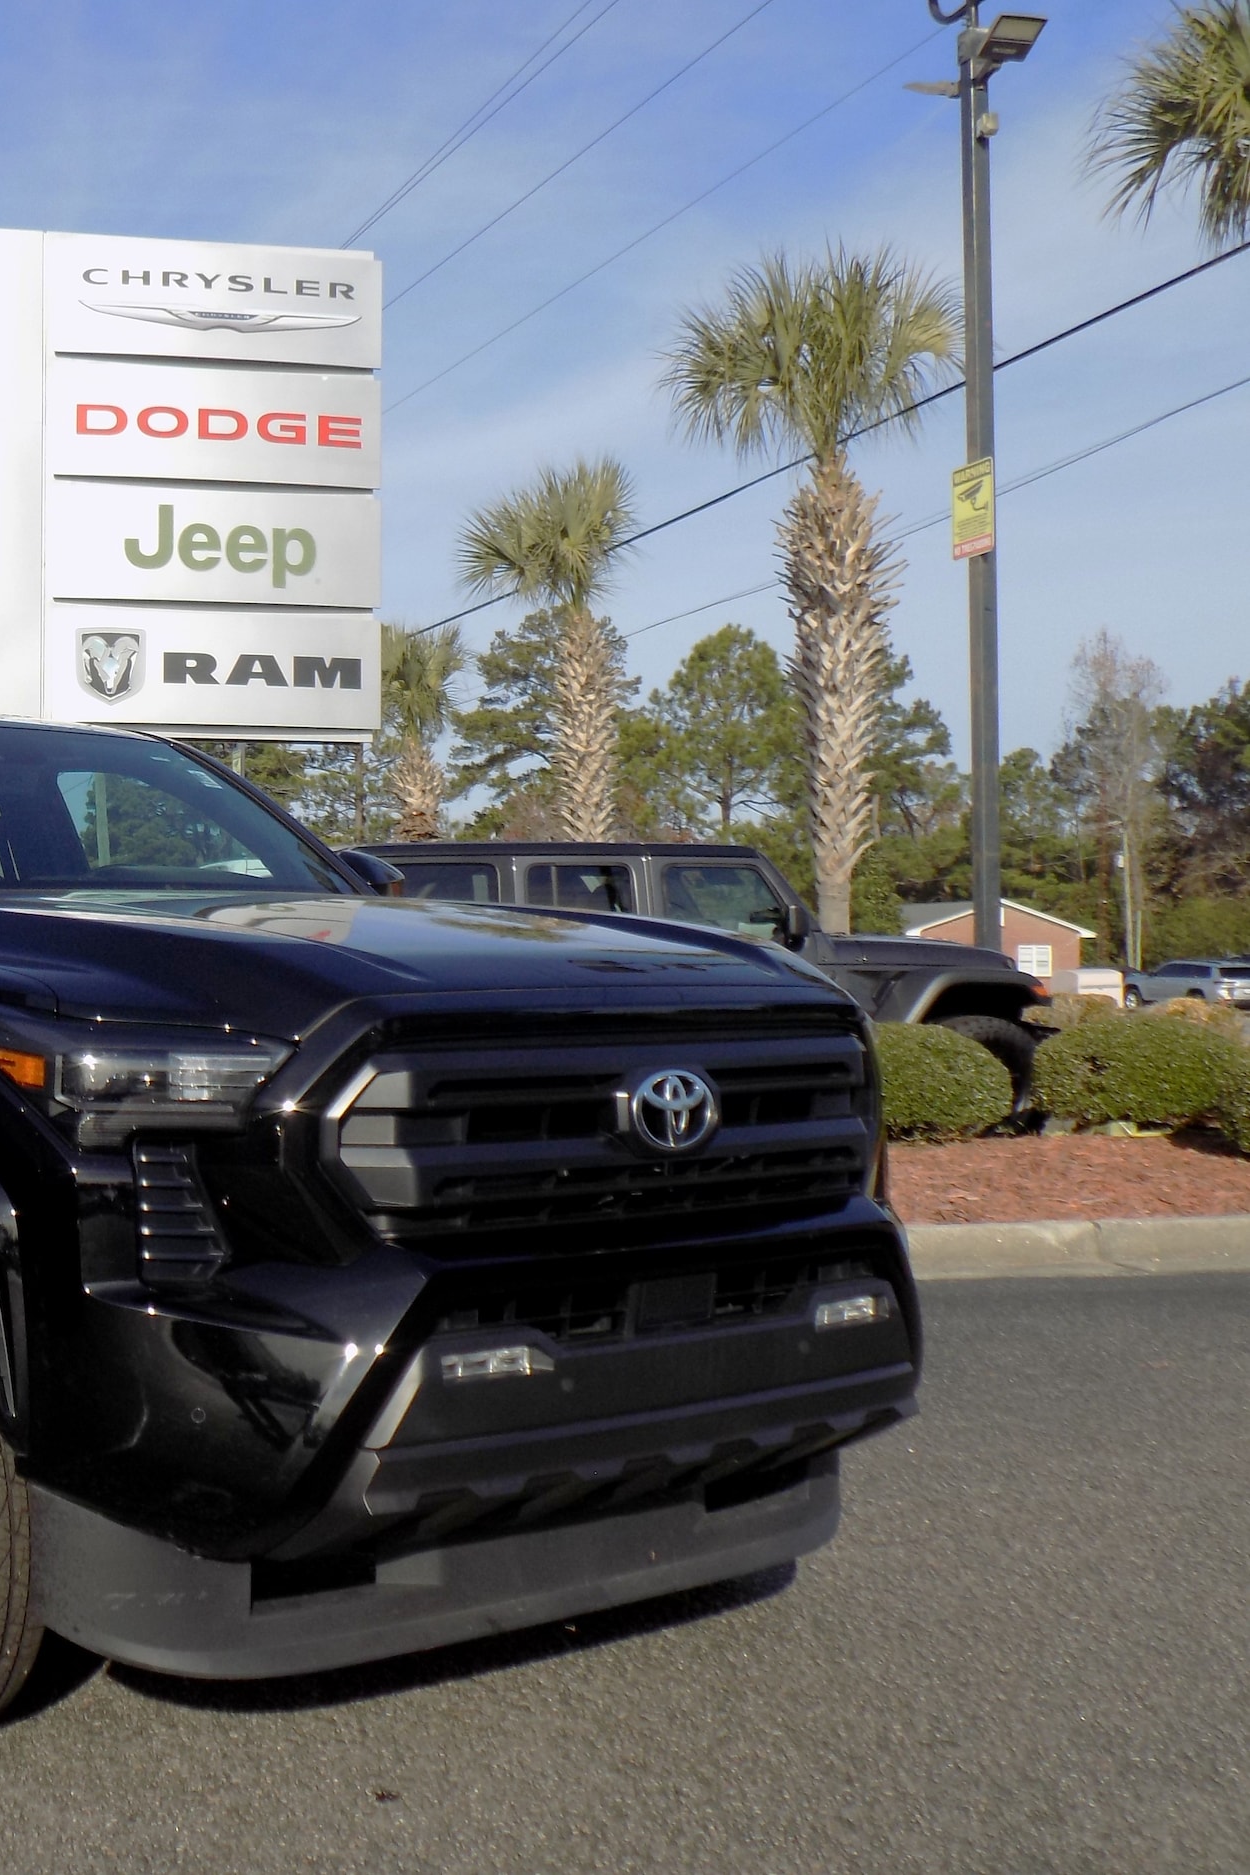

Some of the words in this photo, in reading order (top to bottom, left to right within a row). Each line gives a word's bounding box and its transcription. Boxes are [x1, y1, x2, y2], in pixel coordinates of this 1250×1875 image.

[82, 268, 354, 300] CHRYSLER
[76, 403, 362, 449] DODGE
[124, 504, 316, 588] Jeep
[163, 652, 362, 689] RAM
